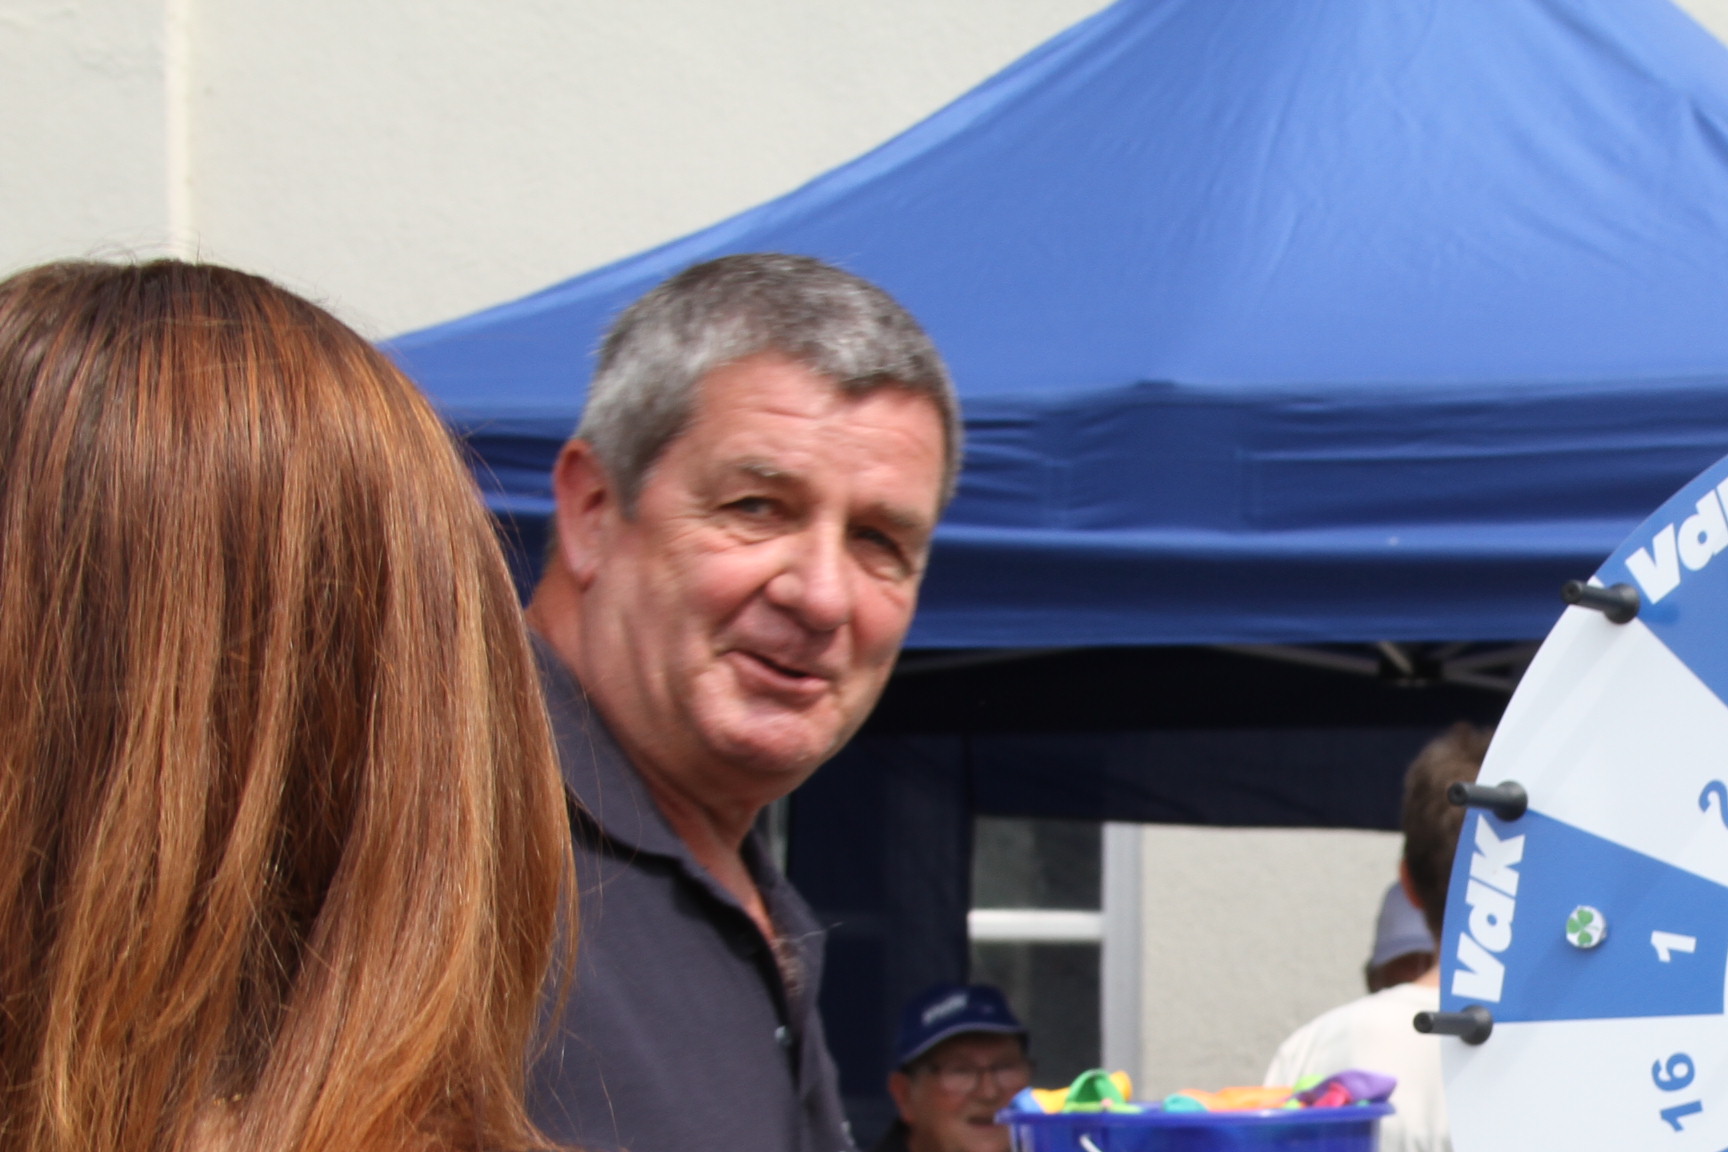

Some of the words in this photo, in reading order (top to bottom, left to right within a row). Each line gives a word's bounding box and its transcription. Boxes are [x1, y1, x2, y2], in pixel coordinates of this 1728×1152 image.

[1451, 813, 1525, 1003] VdK
[1651, 929, 1697, 963] 1
[1651, 1051, 1704, 1133] 16
